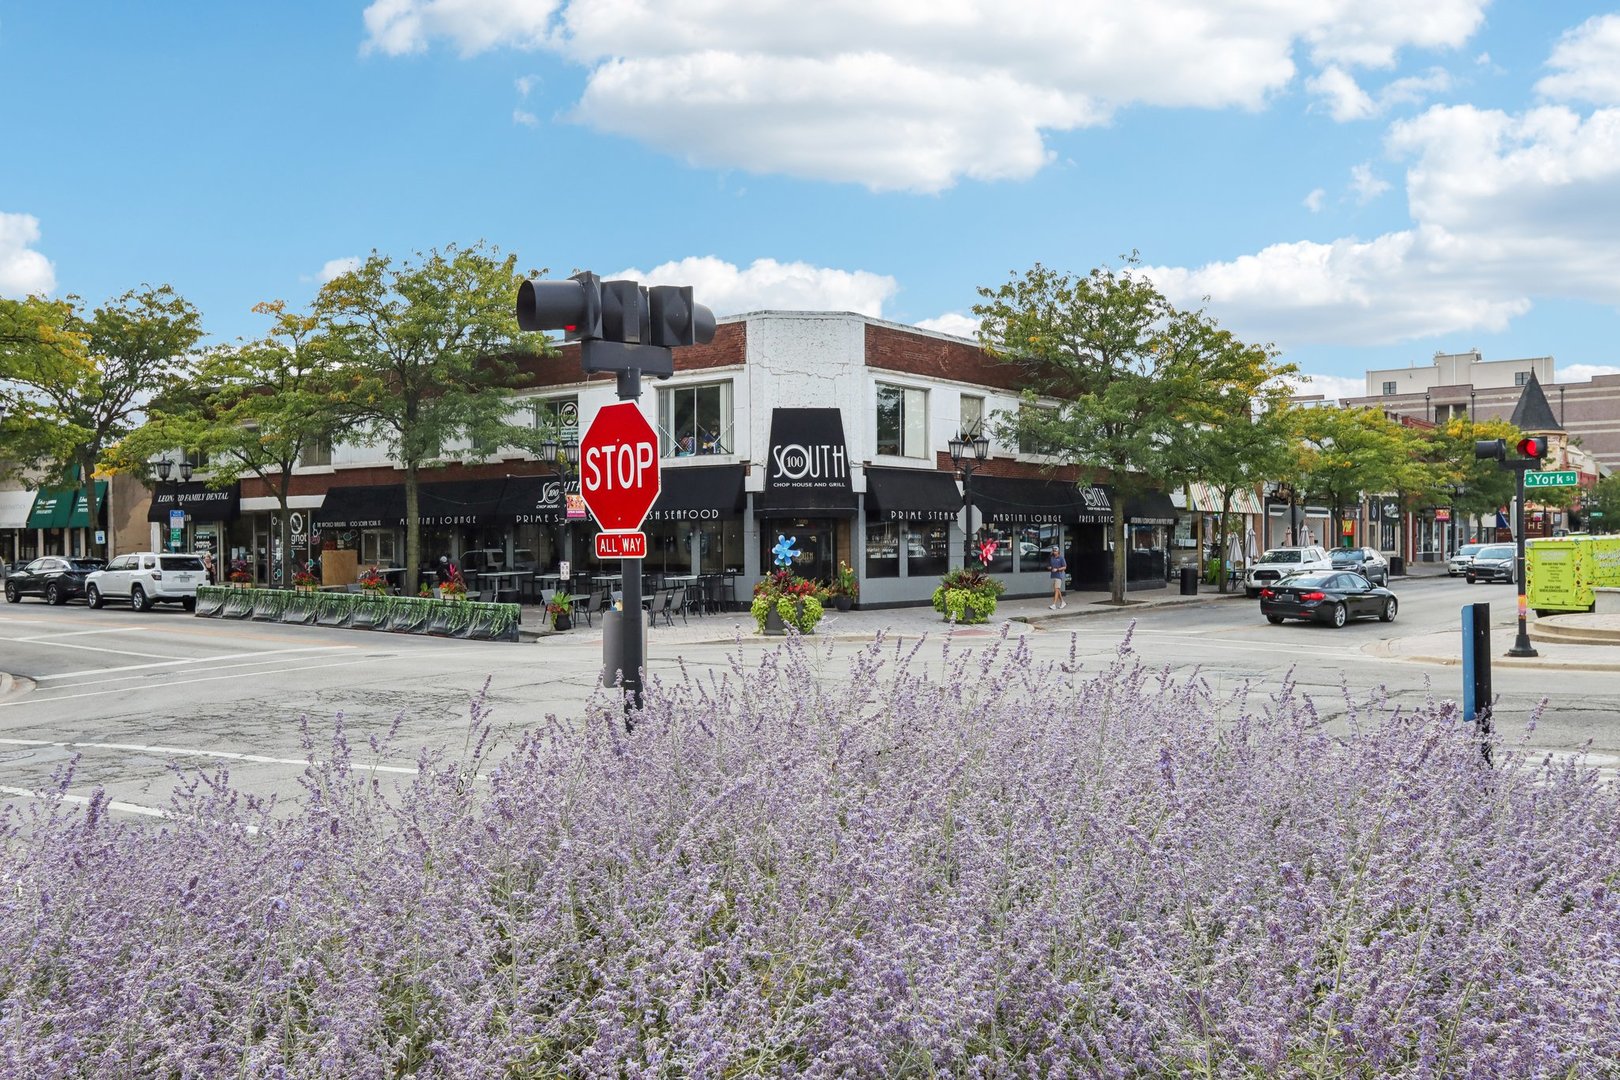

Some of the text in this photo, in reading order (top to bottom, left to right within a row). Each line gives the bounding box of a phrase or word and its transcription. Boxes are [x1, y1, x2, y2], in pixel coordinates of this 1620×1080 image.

[585, 441, 654, 491] STOP
[773, 443, 845, 480] SOUTH
[786, 455, 804, 468] 100
[1534, 474, 1563, 485] York
[184, 493, 205, 502] FAMILY
[205, 491, 229, 501] DENTAL
[548, 488, 560, 497] 100
[440, 515, 476, 525] LOUNGE
[516, 513, 549, 523] PRIME
[664, 509, 719, 520] SEAFOOD
[890, 510, 922, 520] PRIME
[993, 513, 1062, 523] MARTINI LOUNGE
[1527, 521, 1543, 530] HE
[600, 537, 642, 553] ALL WAY
